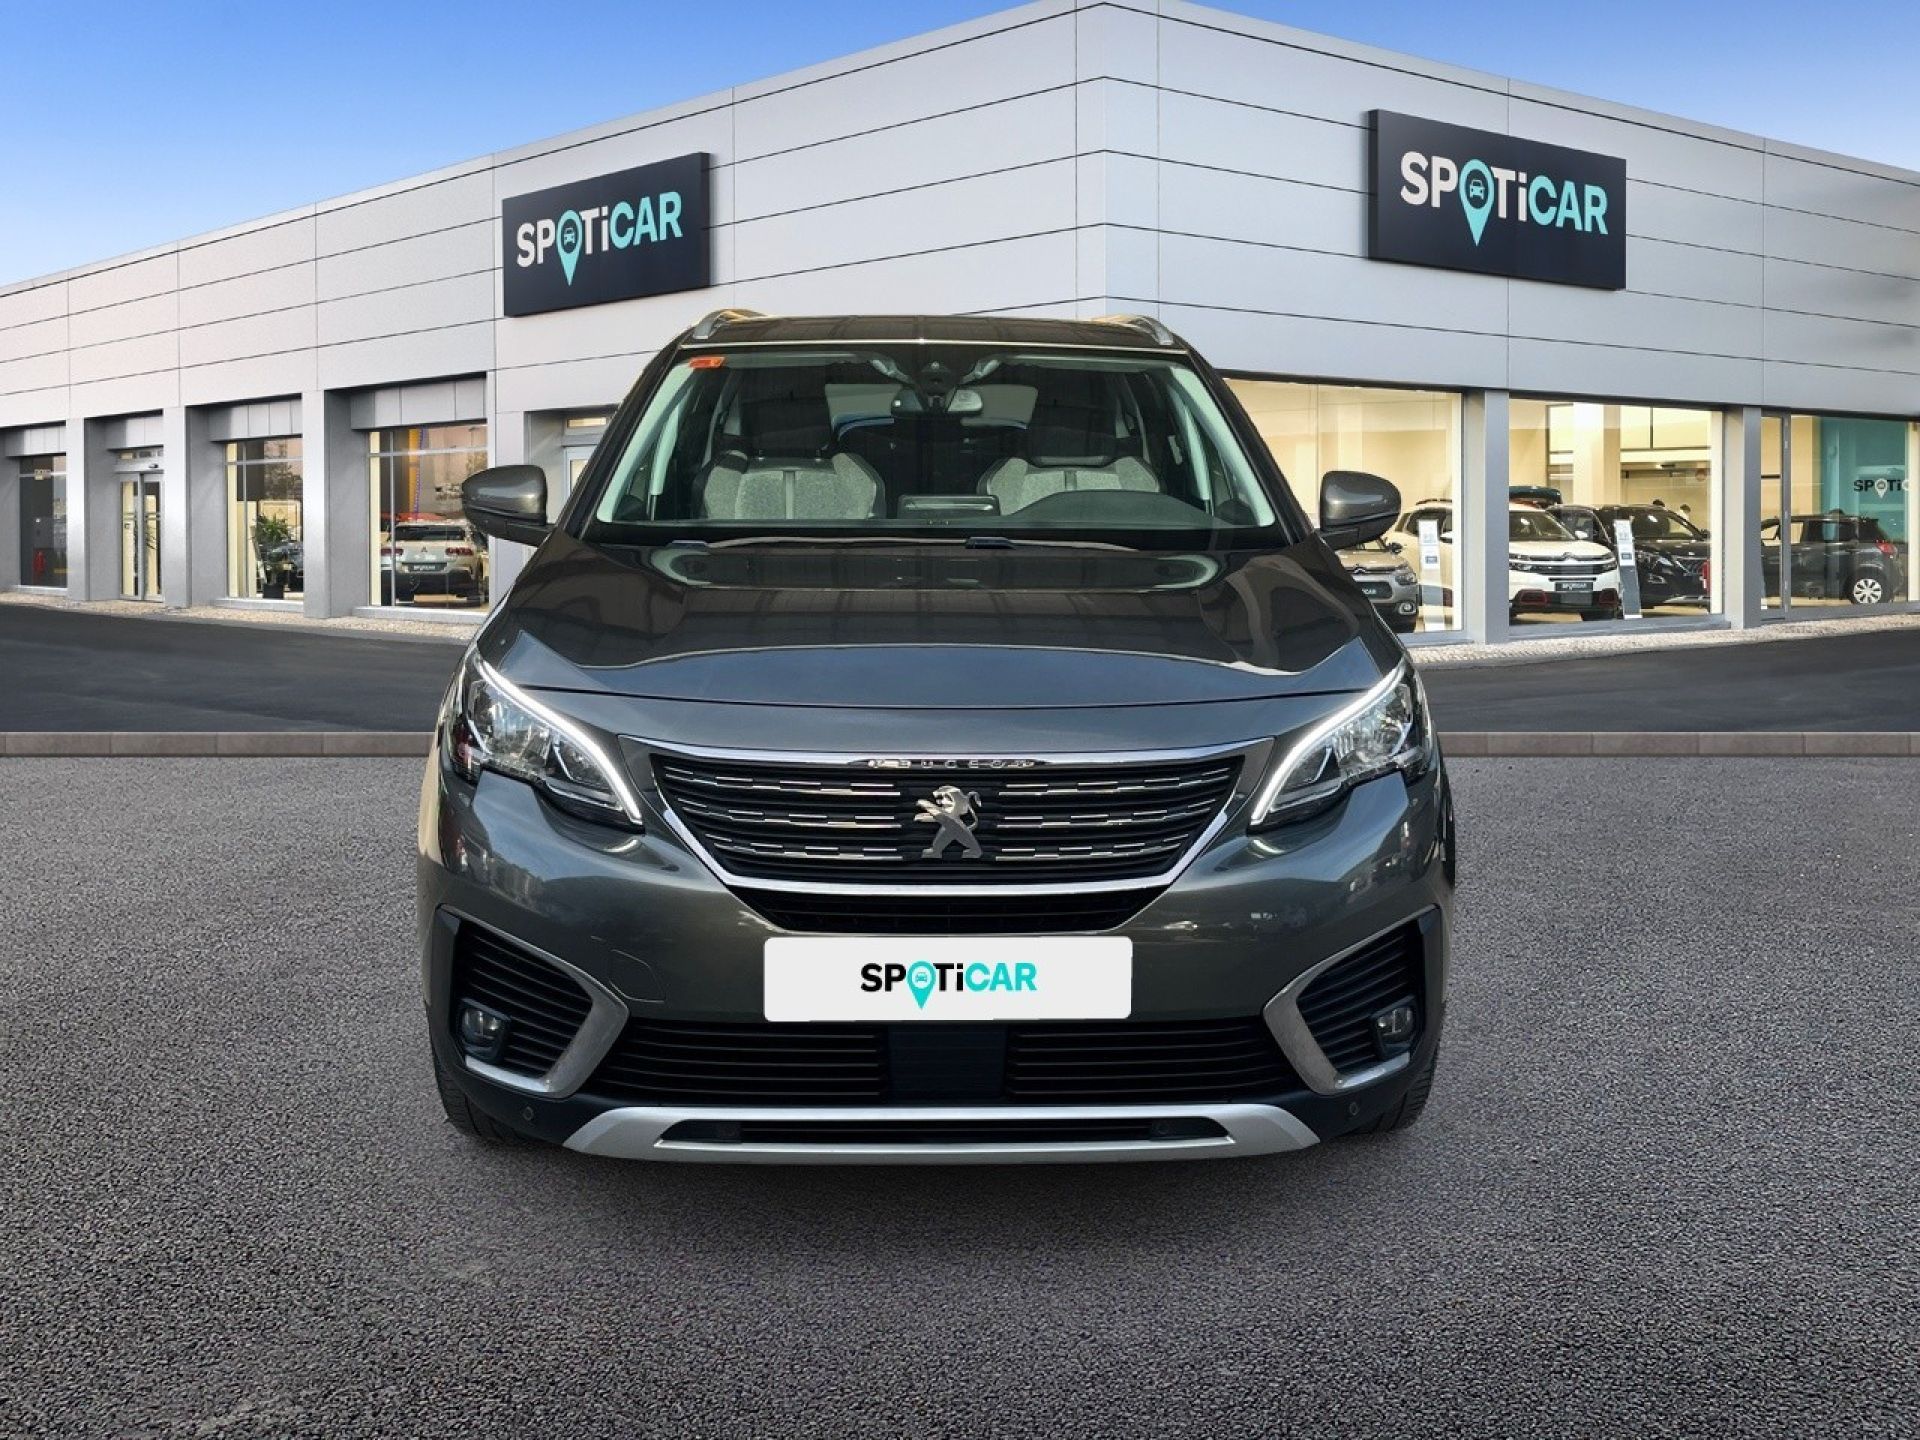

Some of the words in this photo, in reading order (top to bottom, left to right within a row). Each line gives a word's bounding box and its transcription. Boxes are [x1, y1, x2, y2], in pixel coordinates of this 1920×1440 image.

[516, 191, 684, 287] SPOTiCAR
[1400, 151, 1609, 247] SPOTiCAR
[860, 960, 1038, 1010] SPOTiCAR
